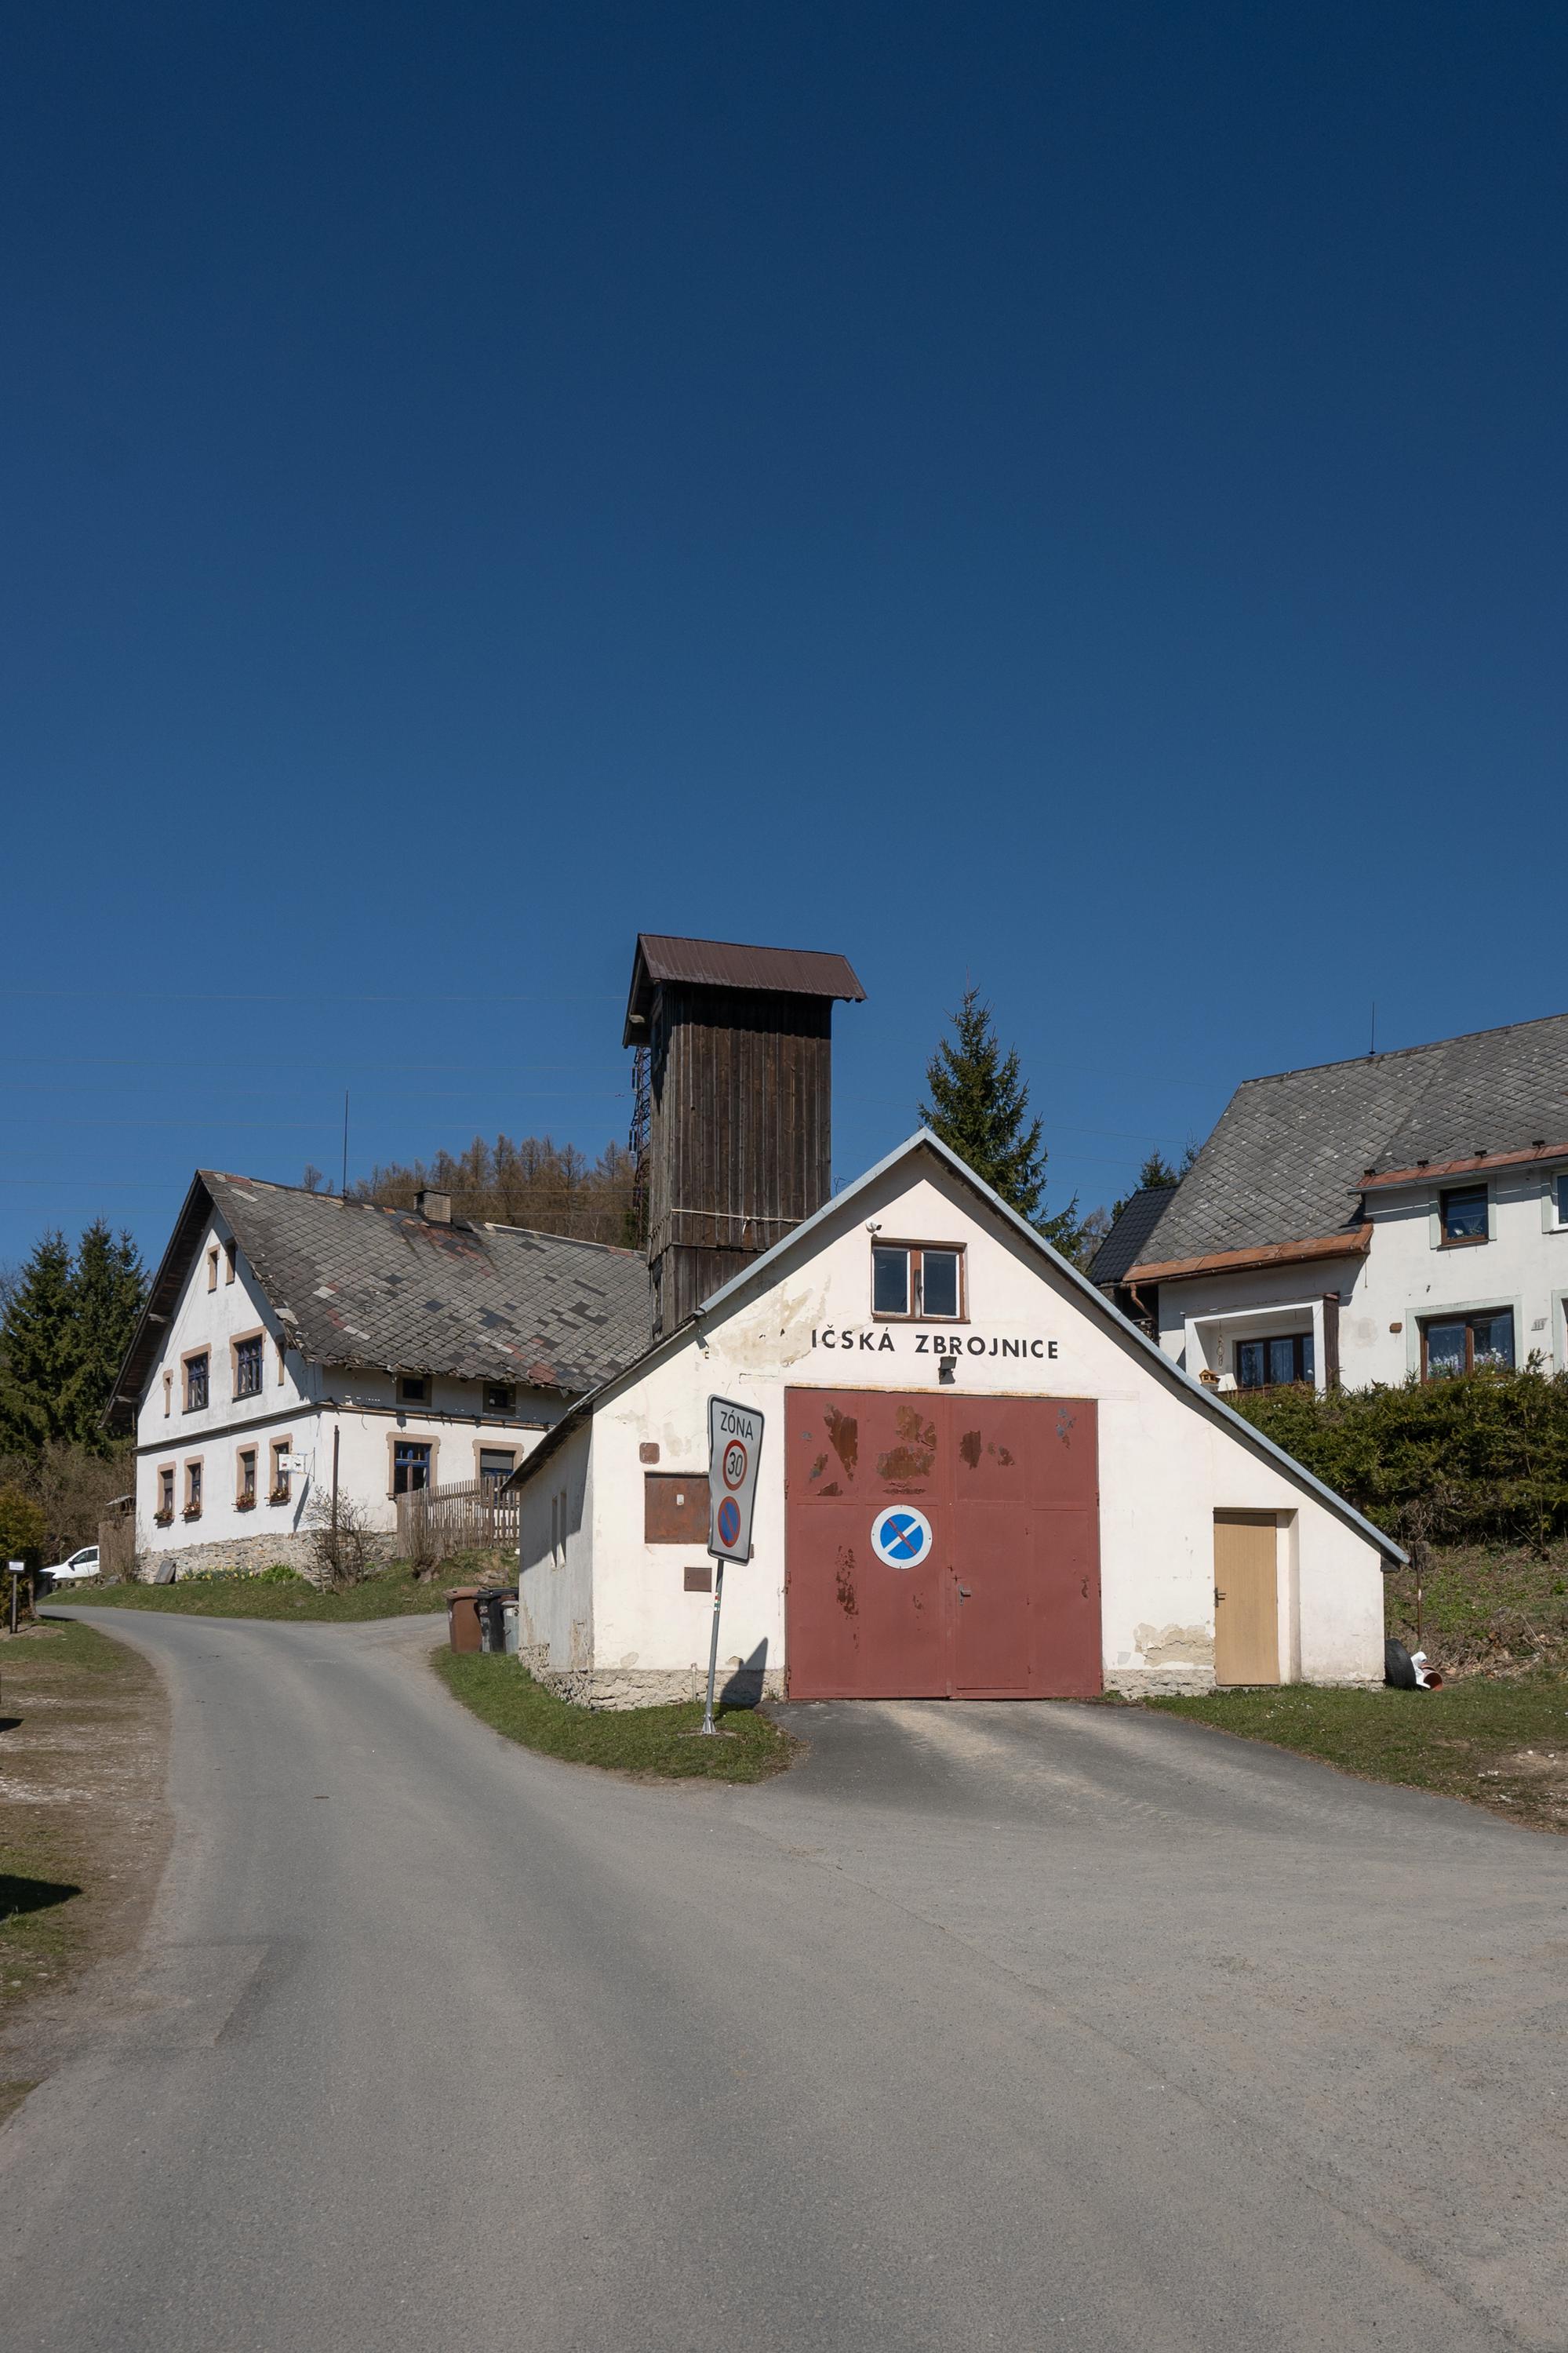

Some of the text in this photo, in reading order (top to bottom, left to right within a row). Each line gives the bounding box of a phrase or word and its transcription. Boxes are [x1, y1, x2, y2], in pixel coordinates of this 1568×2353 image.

[759, 1324, 1058, 1359] IČSKÁ ZBROJNICE
[720, 1409, 754, 1441] ZÓNA
[727, 1452, 744, 1478] 30
